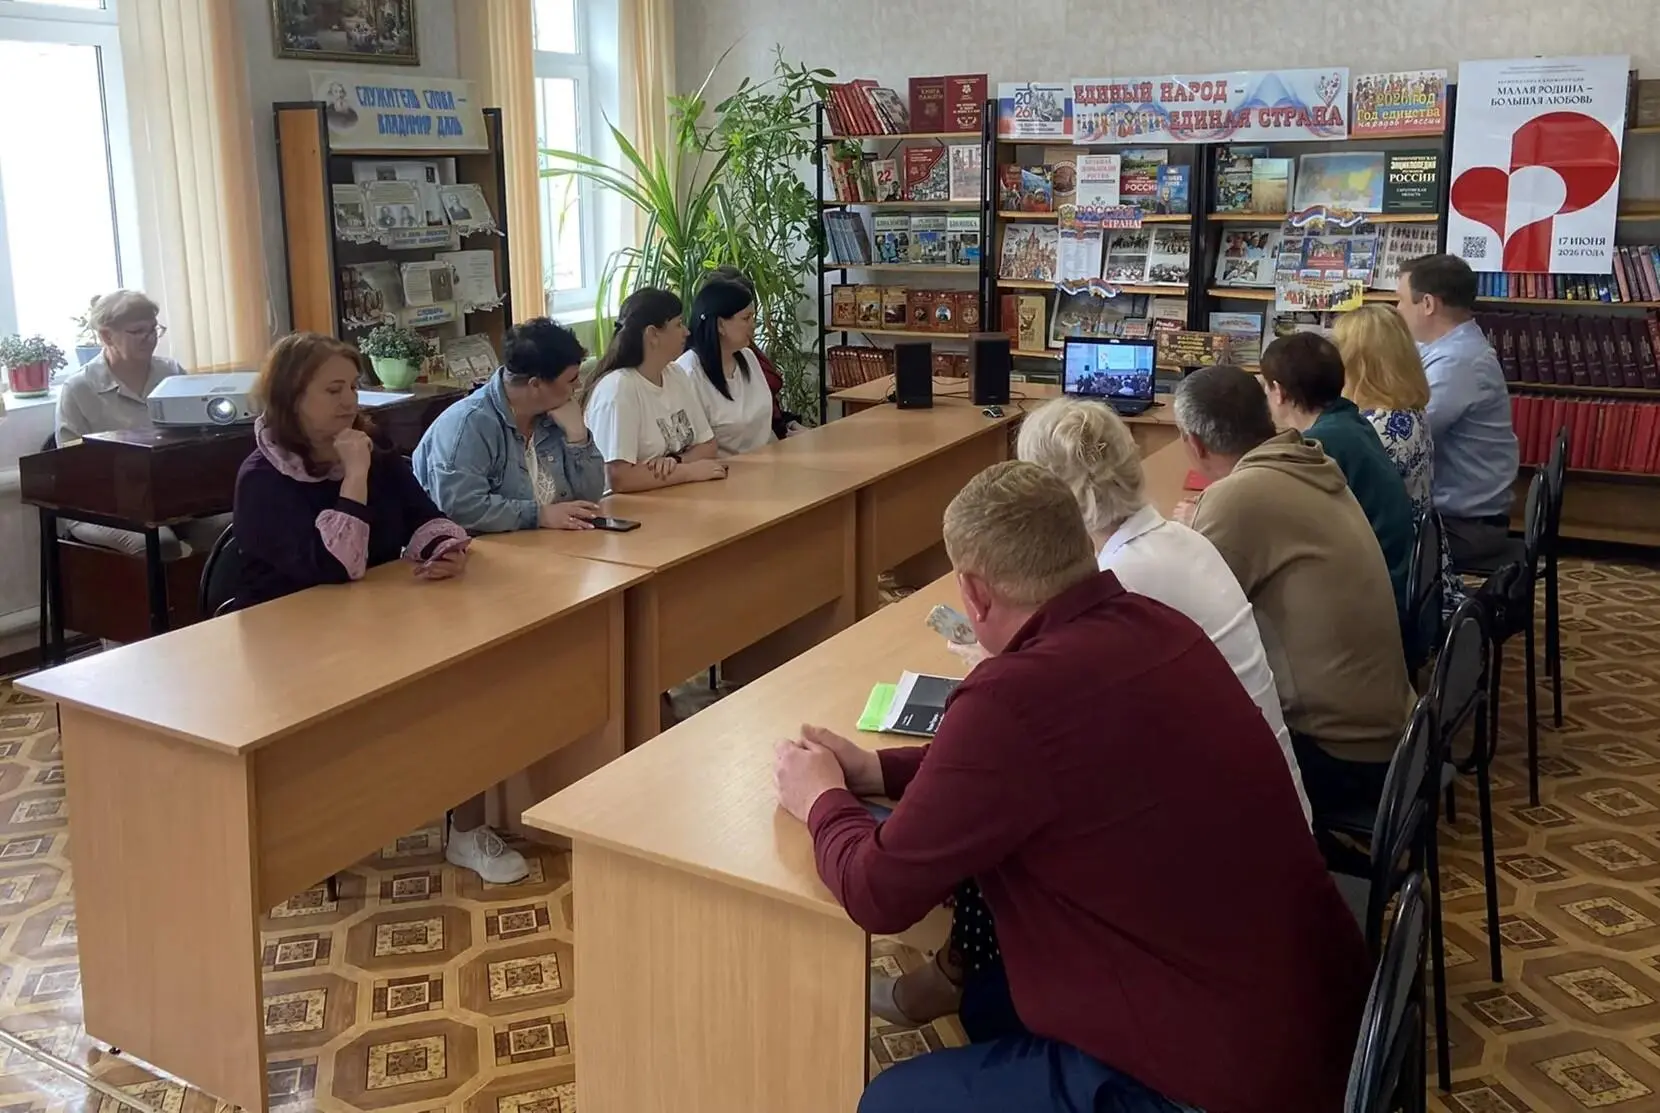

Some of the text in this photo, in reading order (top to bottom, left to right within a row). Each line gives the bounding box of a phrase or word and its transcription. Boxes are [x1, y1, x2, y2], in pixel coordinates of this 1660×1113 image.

[1074, 81, 1153, 105] ЕДИНЫЙ
[1160, 80, 1228, 104] НАРОД
[1497, 86, 1536, 95] МАЛАЯ
[1538, 84, 1584, 95] РОДИНА
[356, 86, 421, 109] СЛУЖИТЕЛЬ
[422, 89, 456, 110] СЛОВА
[1015, 91, 1032, 105] 20
[1491, 95, 1593, 107] БОЛЬШАЯ ЛЮБОВЬ
[1015, 106, 1031, 118] 26
[1170, 105, 1344, 132] ЕДИНАЯ СТРАНА
[1357, 107, 1440, 121] Год единства
[377, 113, 463, 136] ВЛАДИМИР ДАЛЬ
[876, 169, 892, 183] 22
[1389, 173, 1436, 183] РОССИИ
[1558, 236, 1606, 246] 17 ИЮНЯ
[1580, 249, 1605, 257] ГОДА
